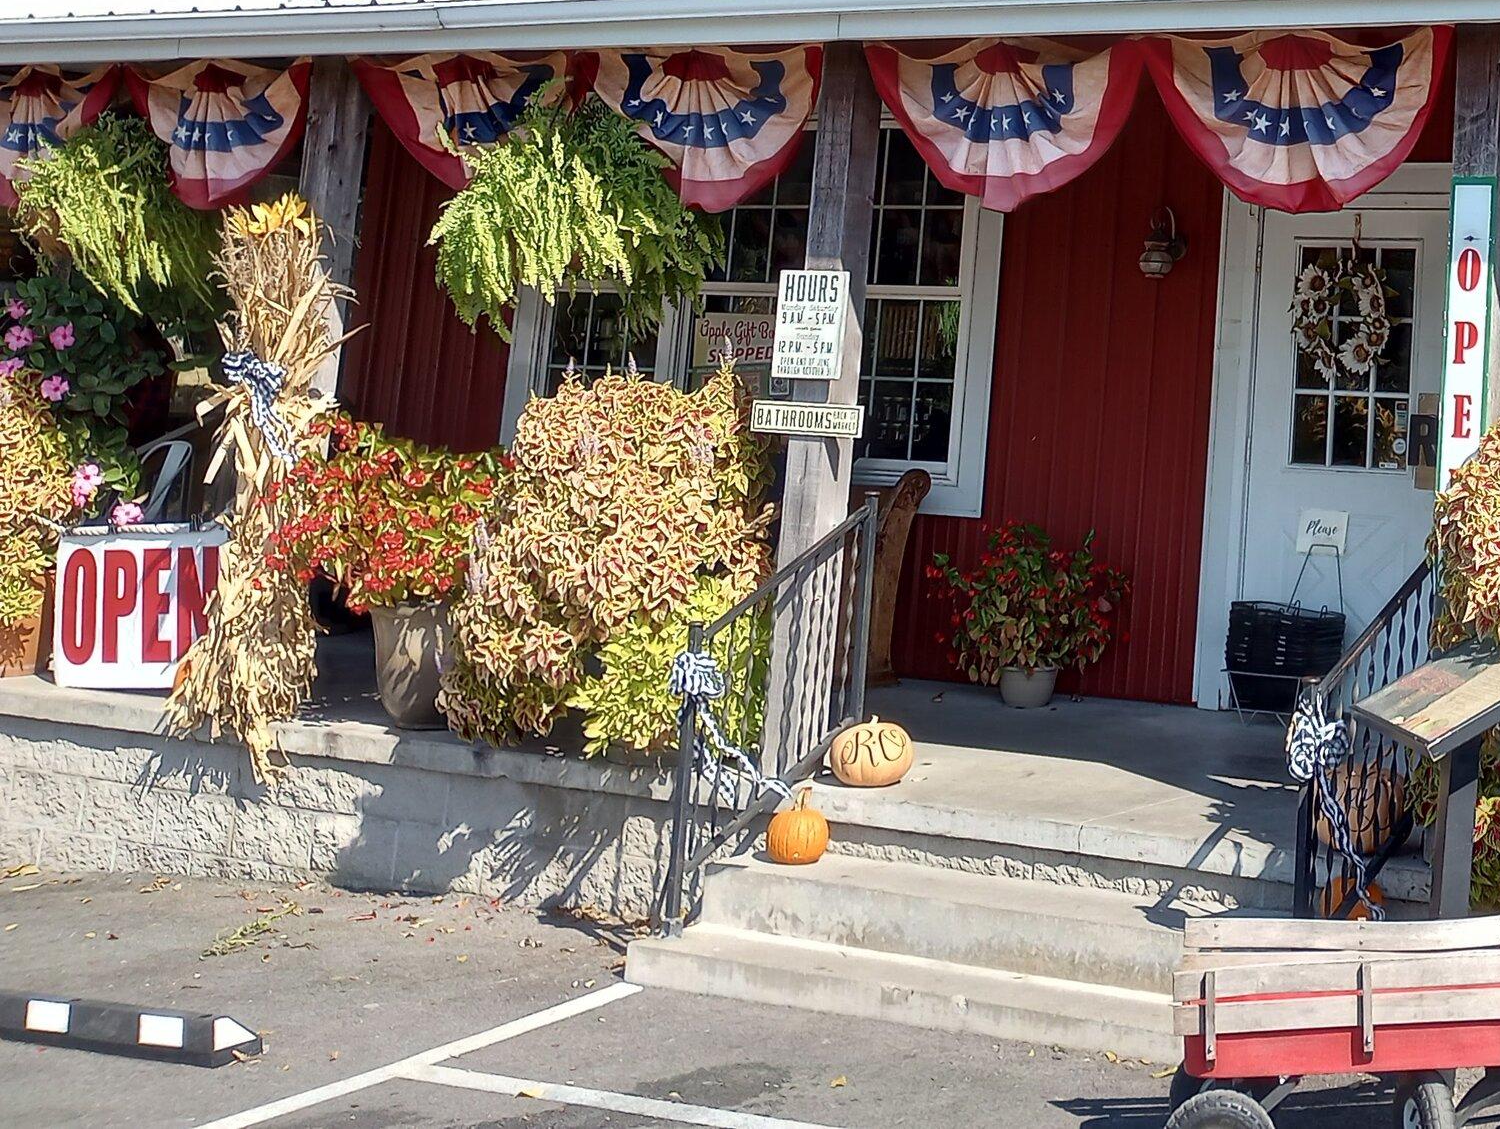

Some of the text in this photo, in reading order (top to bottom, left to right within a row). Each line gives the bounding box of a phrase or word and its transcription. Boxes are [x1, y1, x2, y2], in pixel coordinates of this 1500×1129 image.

[785, 273, 839, 303] HOURS
[700, 320, 732, 345] Apple
[735, 321, 757, 346] Gift
[778, 340, 787, 353] 12
[813, 341, 818, 354] 5
[1449, 248, 1482, 481] OPE
[757, 408, 832, 429] BATHROOMS
[1305, 518, 1338, 537] Please
[61, 546, 220, 666] OPEN
